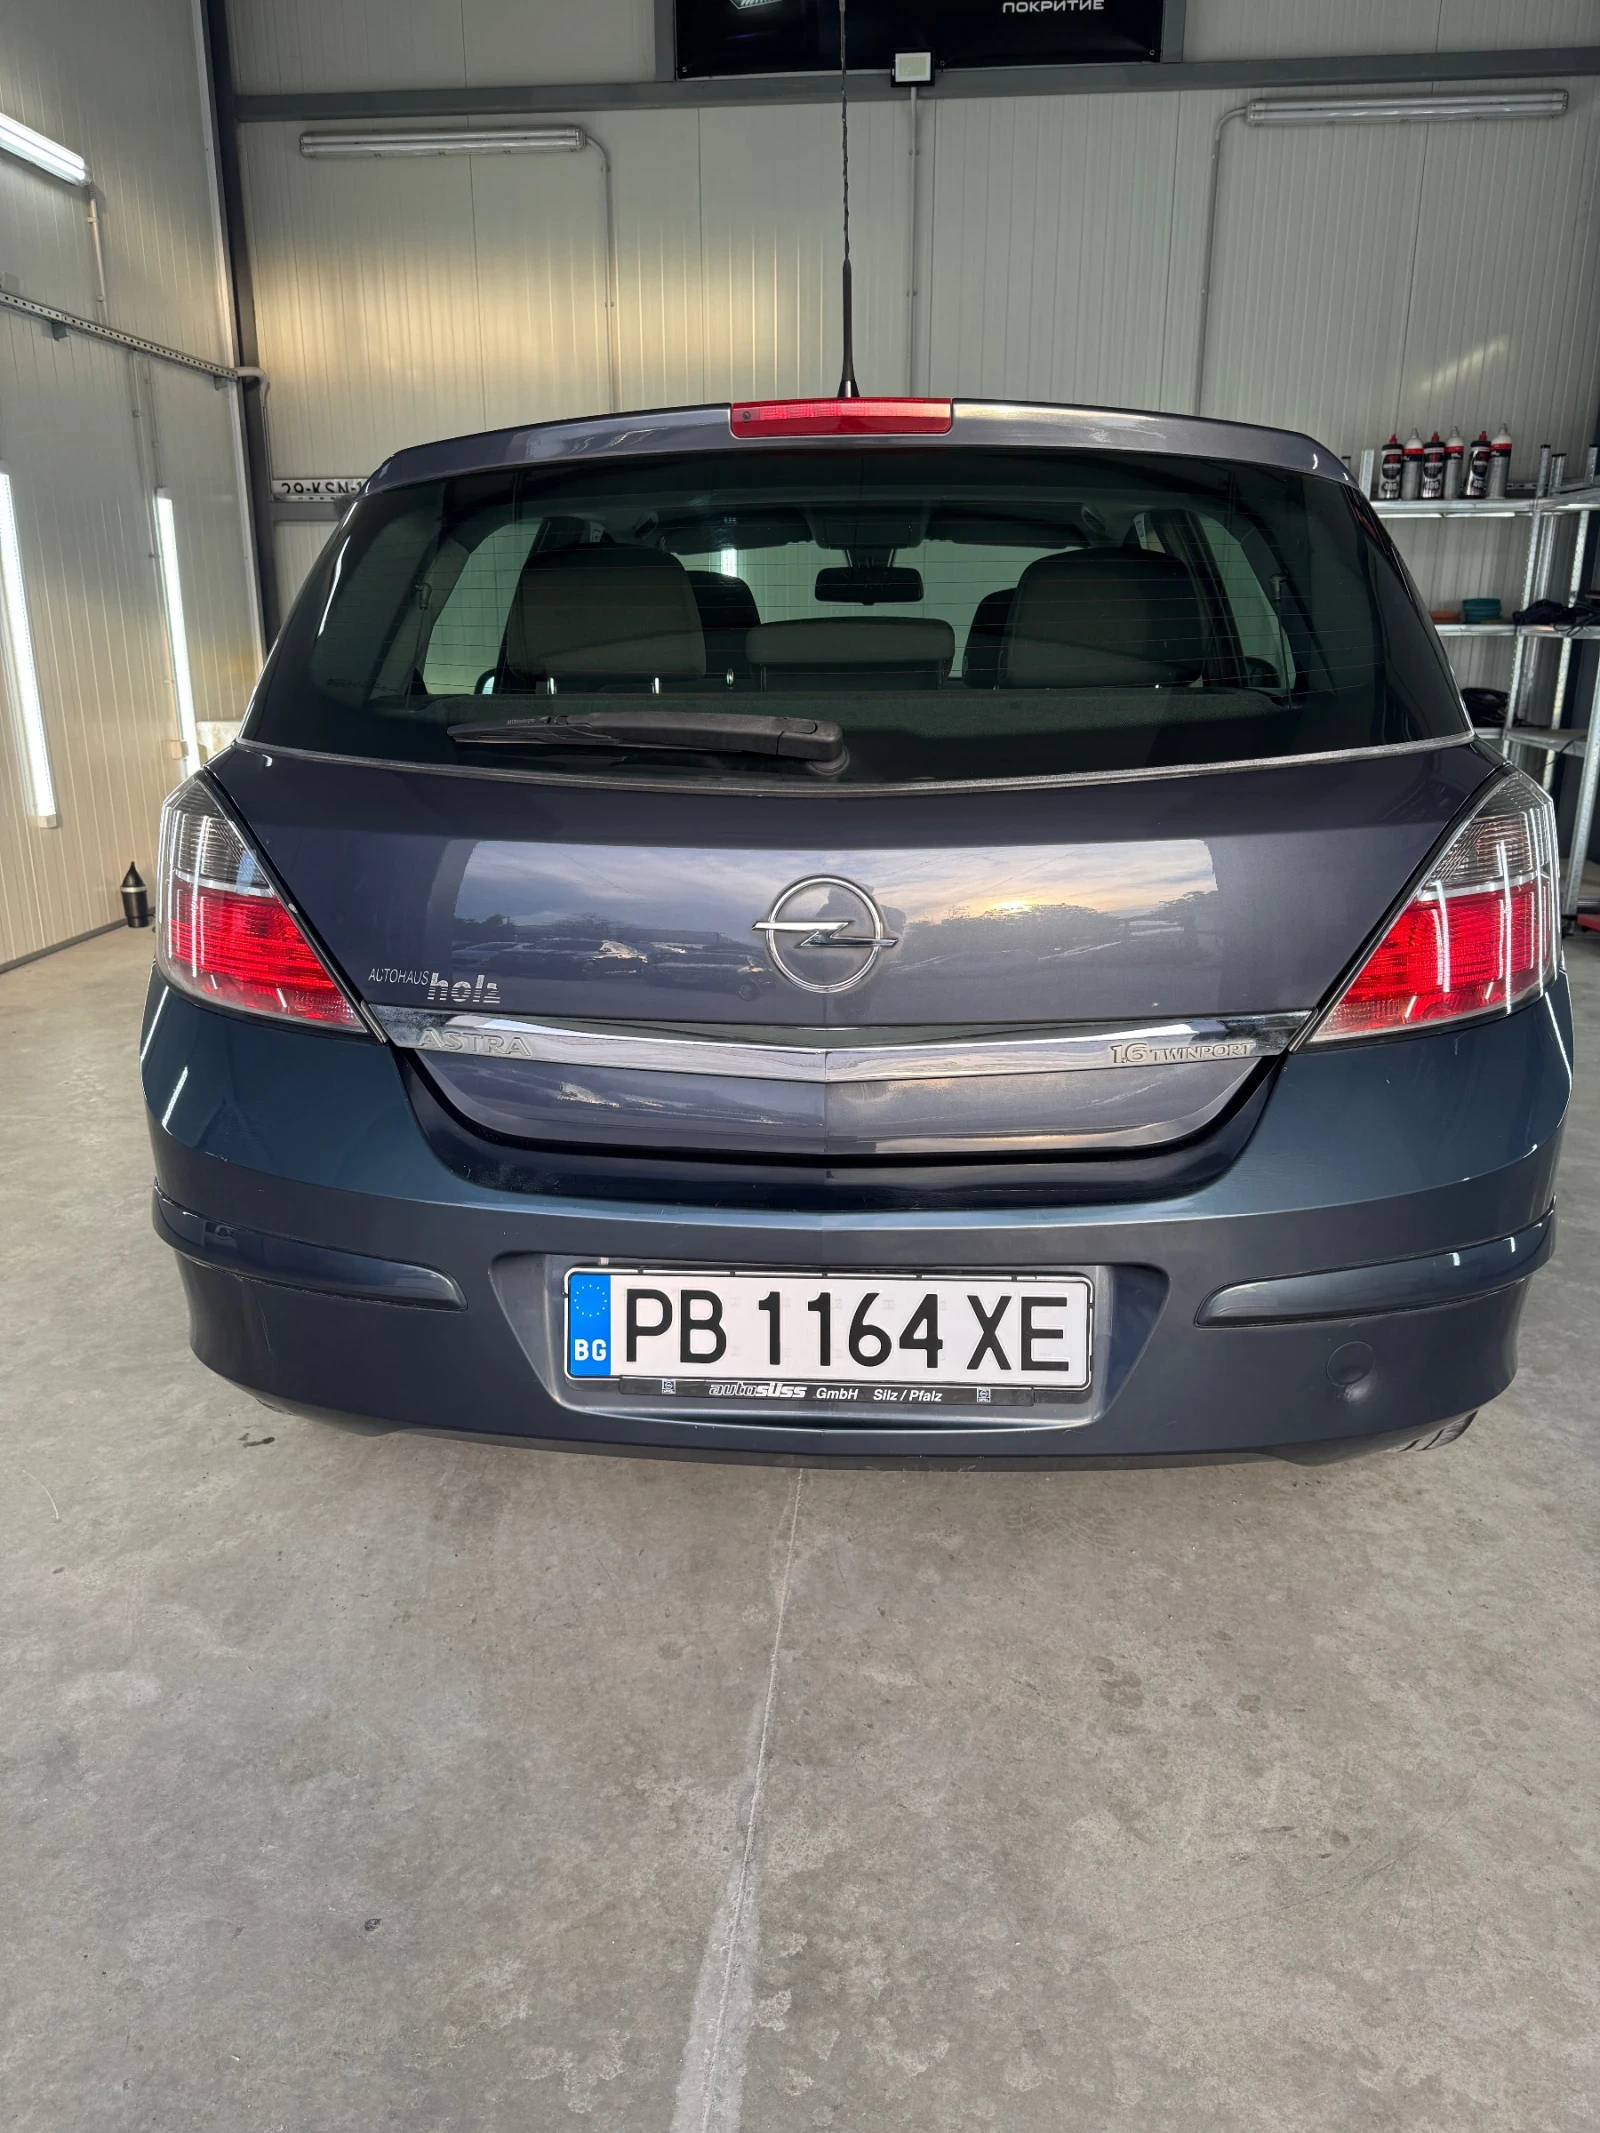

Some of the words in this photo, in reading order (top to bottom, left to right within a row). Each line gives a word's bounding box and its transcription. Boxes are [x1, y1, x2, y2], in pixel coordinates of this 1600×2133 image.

[1002, 0, 1105, 13] ПОКРИТИЕ
[368, 967, 430, 986] AUTOHAUS
[418, 1027, 532, 1057] ASTRA
[1150, 1043, 1256, 1062] TWINPORT
[626, 1288, 727, 1364] PB
[758, 1290, 943, 1370] 1164
[966, 1294, 1069, 1372] XE
[574, 1338, 607, 1362] BG
[816, 1387, 859, 1400] GmbH
[873, 1389, 897, 1402] Silz
[909, 1390, 943, 1403] Pfalz
